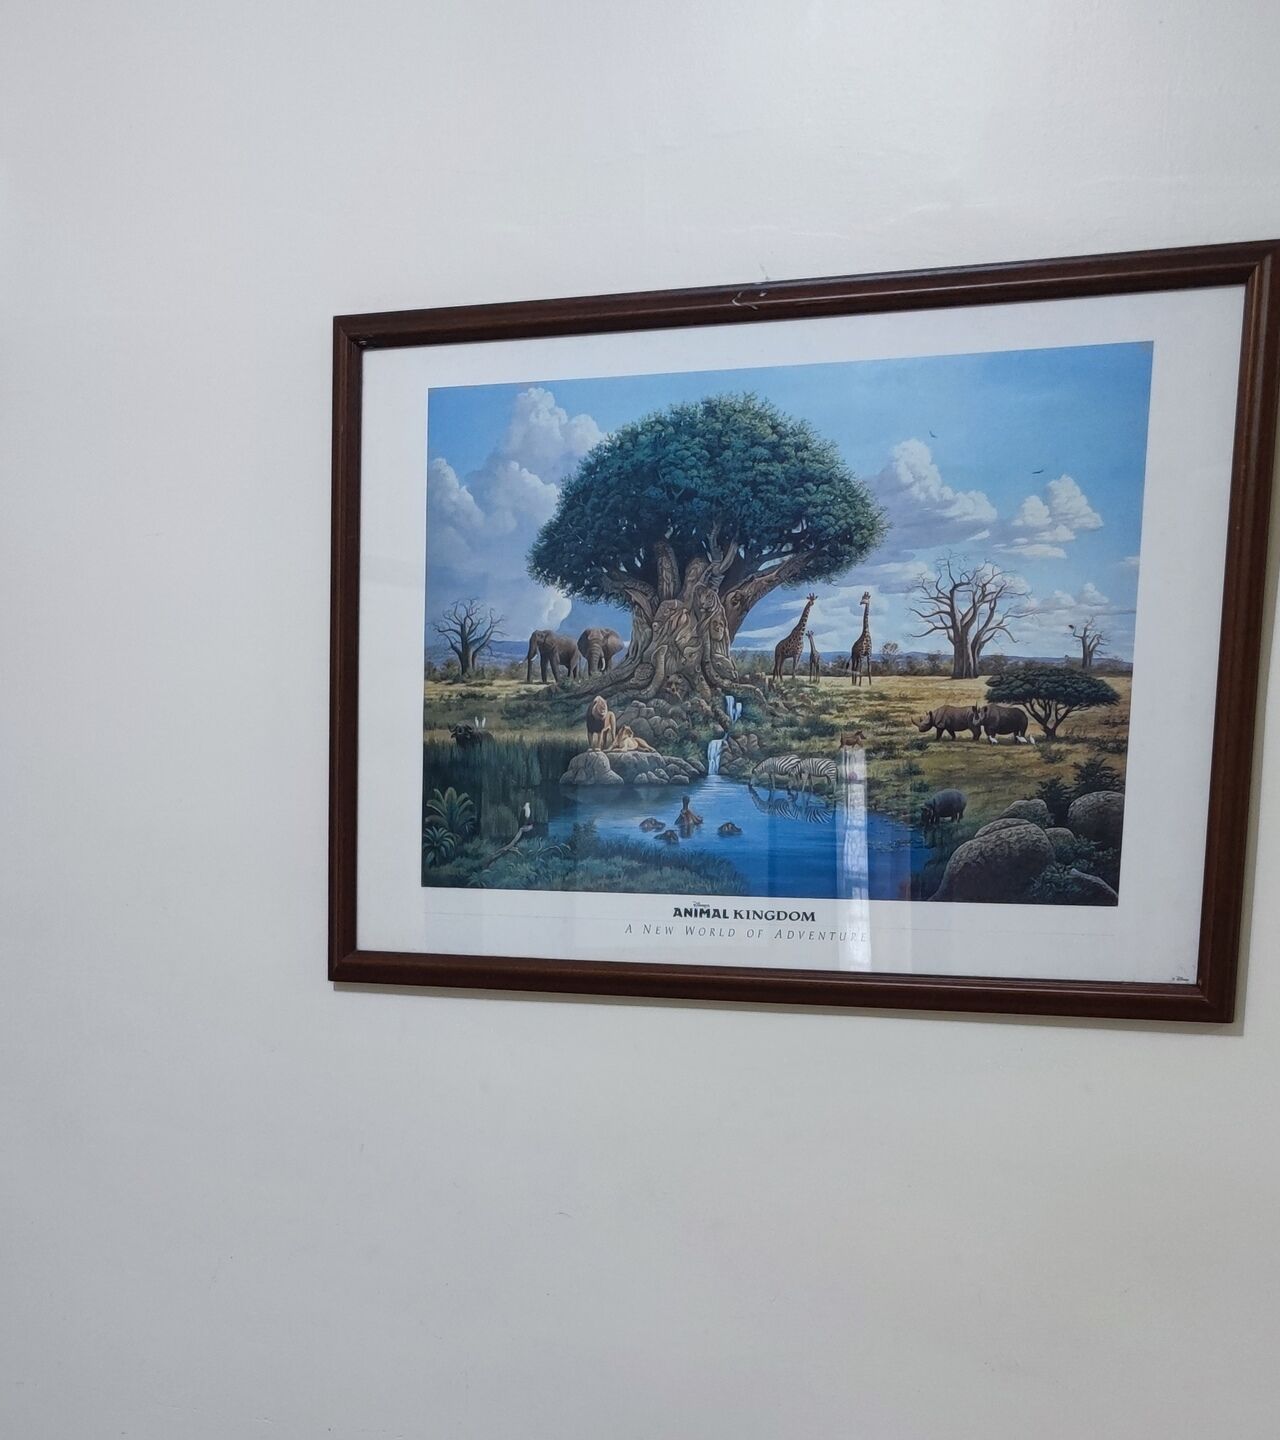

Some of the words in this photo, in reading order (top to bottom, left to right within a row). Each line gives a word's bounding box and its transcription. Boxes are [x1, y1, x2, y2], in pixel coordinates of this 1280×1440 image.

[673, 907, 730, 919] ANIMAL
[733, 909, 816, 922] KINGDOM
[624, 924, 633, 934] A
[643, 924, 674, 935] NEW
[685, 925, 736, 937] WORLD
[746, 928, 764, 939] OF
[774, 929, 868, 942] ADVENTURE
